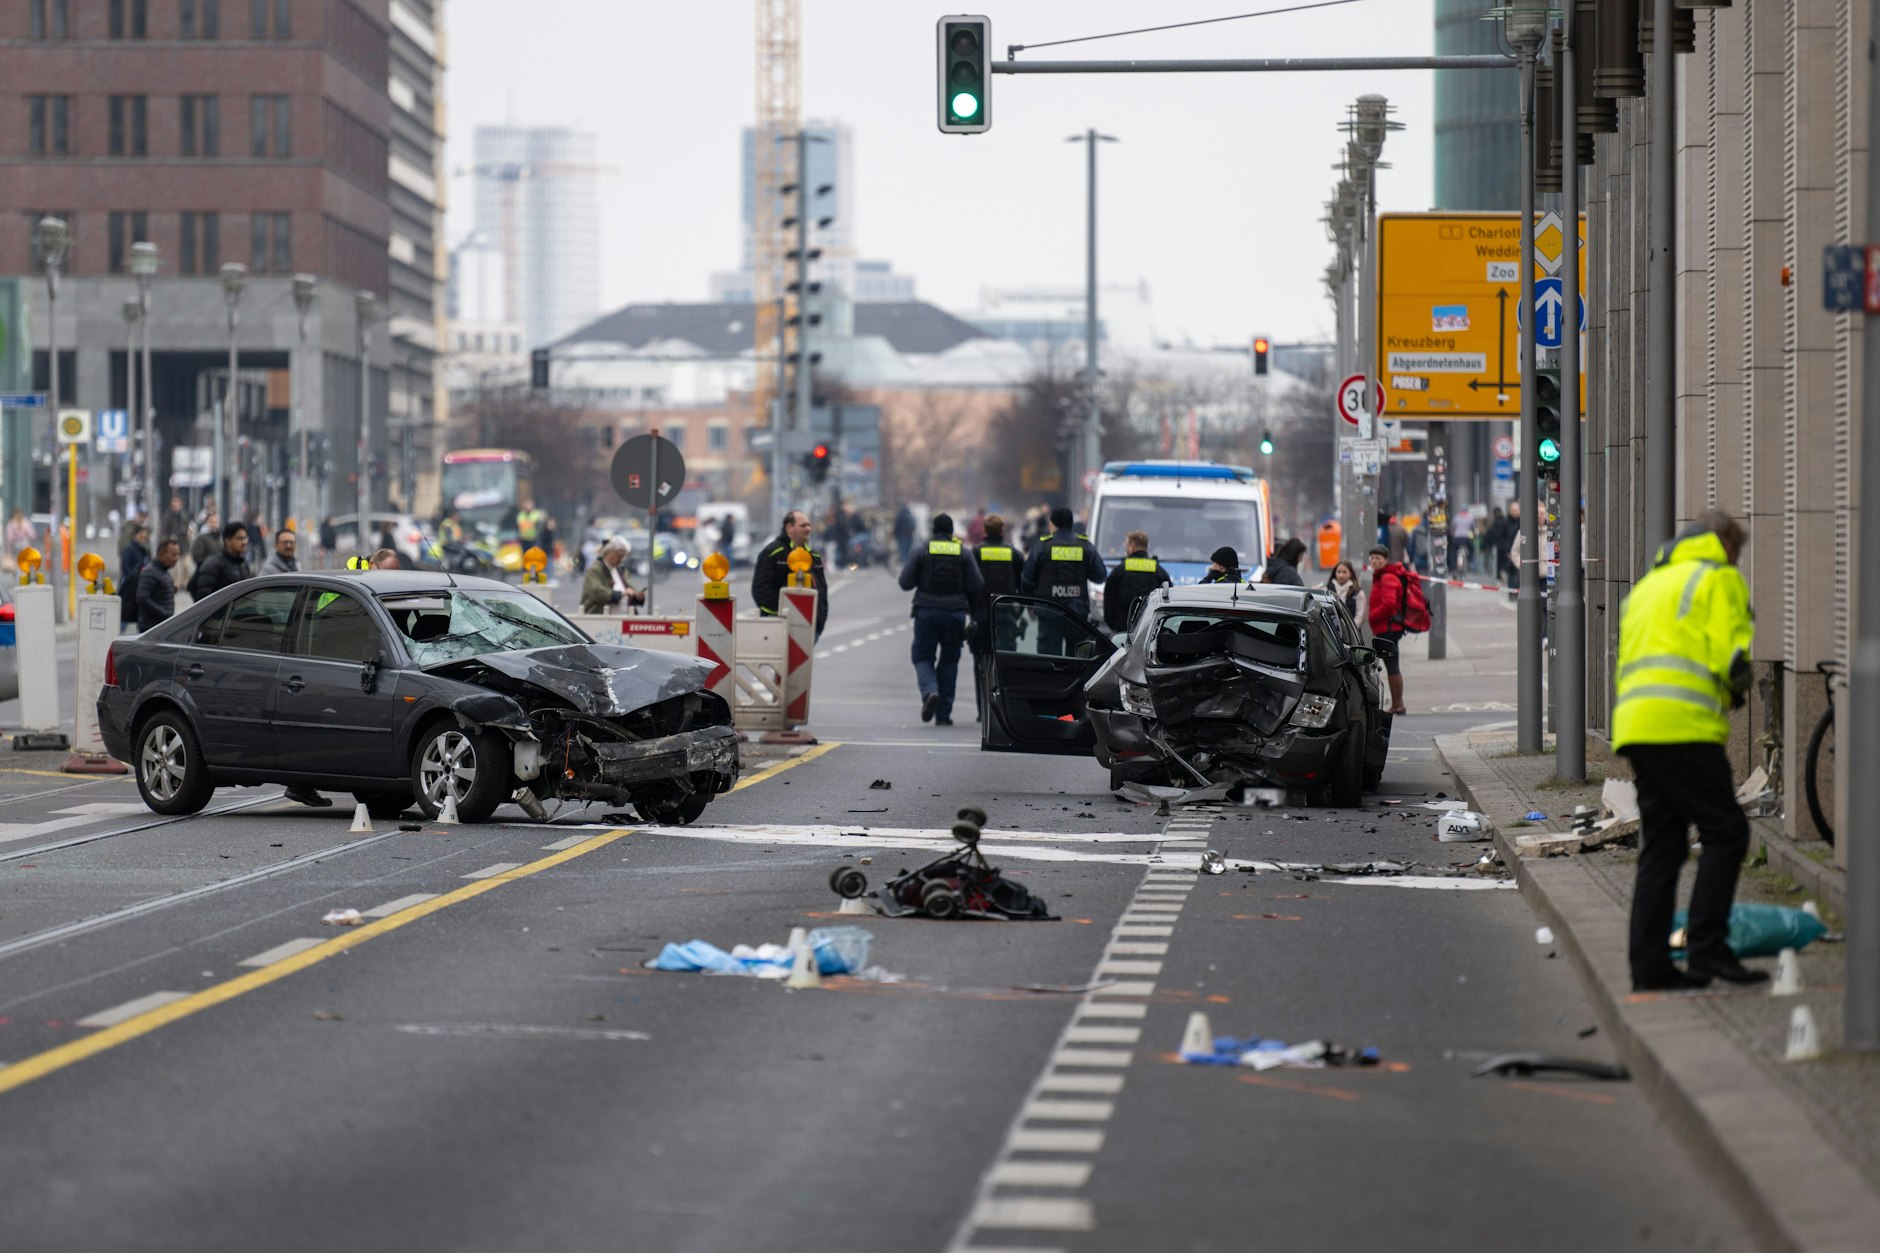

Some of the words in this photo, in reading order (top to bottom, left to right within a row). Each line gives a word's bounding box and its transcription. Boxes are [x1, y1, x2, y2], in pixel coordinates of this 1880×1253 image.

[1468, 226, 1522, 239] Charlott
[1490, 265, 1515, 279] Zoo
[1387, 335, 1455, 351] Kreuzberg
[1392, 356, 1483, 371] Abgeordnetenhaus
[1051, 547, 1083, 560] POLIZEI
[1052, 585, 1081, 598] POLIZEI
[629, 623, 666, 632] ZEPPELIN
